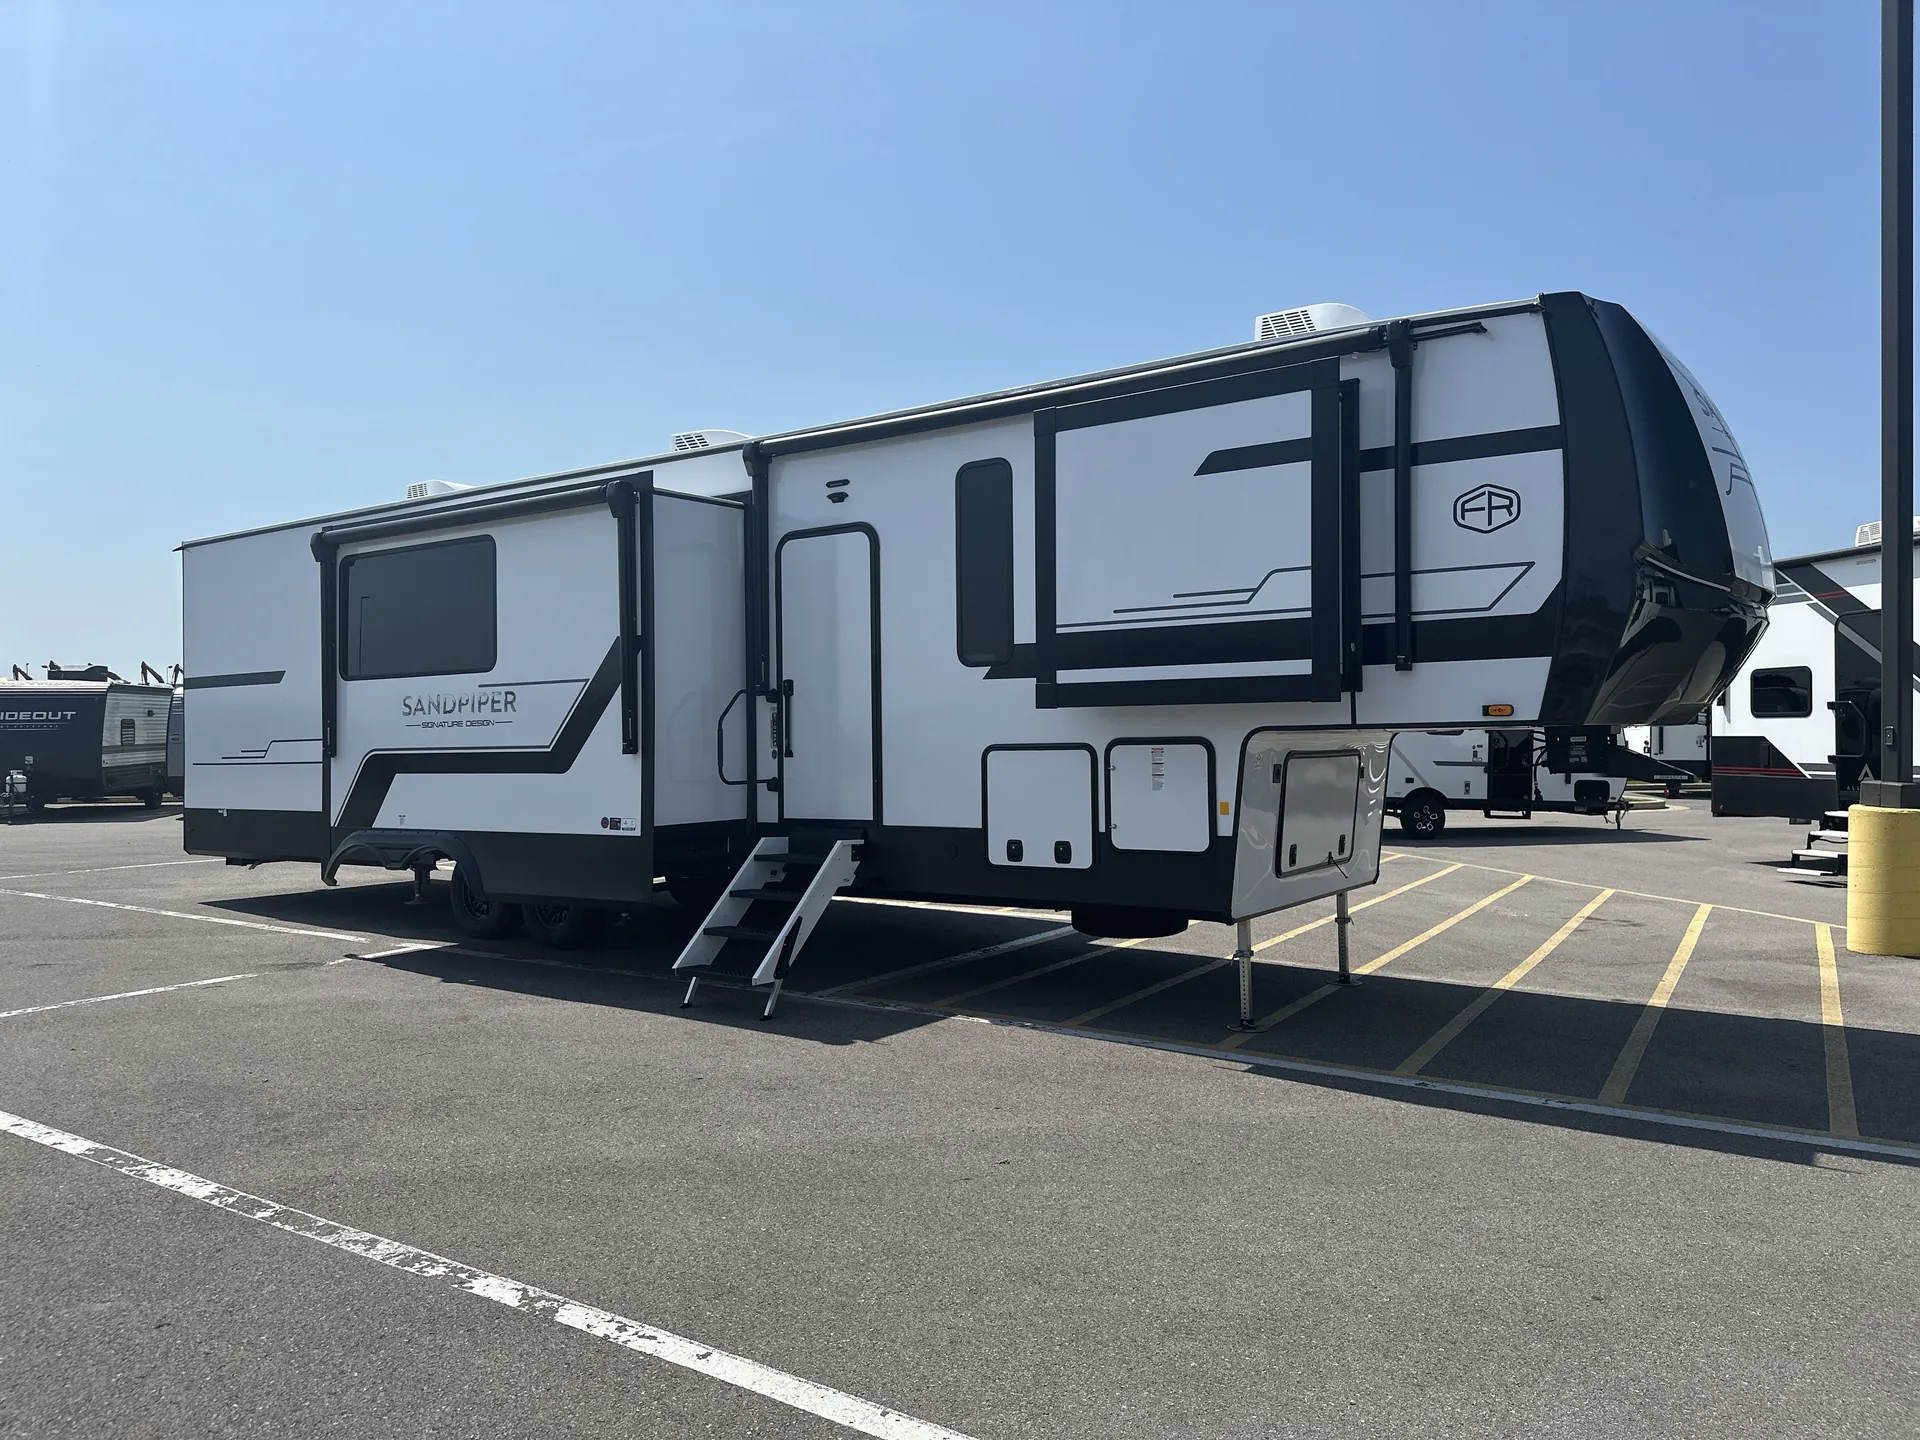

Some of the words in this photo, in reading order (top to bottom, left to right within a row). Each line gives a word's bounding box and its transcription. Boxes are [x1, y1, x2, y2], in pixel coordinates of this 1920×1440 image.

[1460, 490, 1514, 527] FR
[402, 690, 517, 717] SANDPIPER
[0, 711, 77, 720] IDEOUT
[421, 720, 463, 729] SIGNATURE
[465, 719, 495, 728] DESIGN
